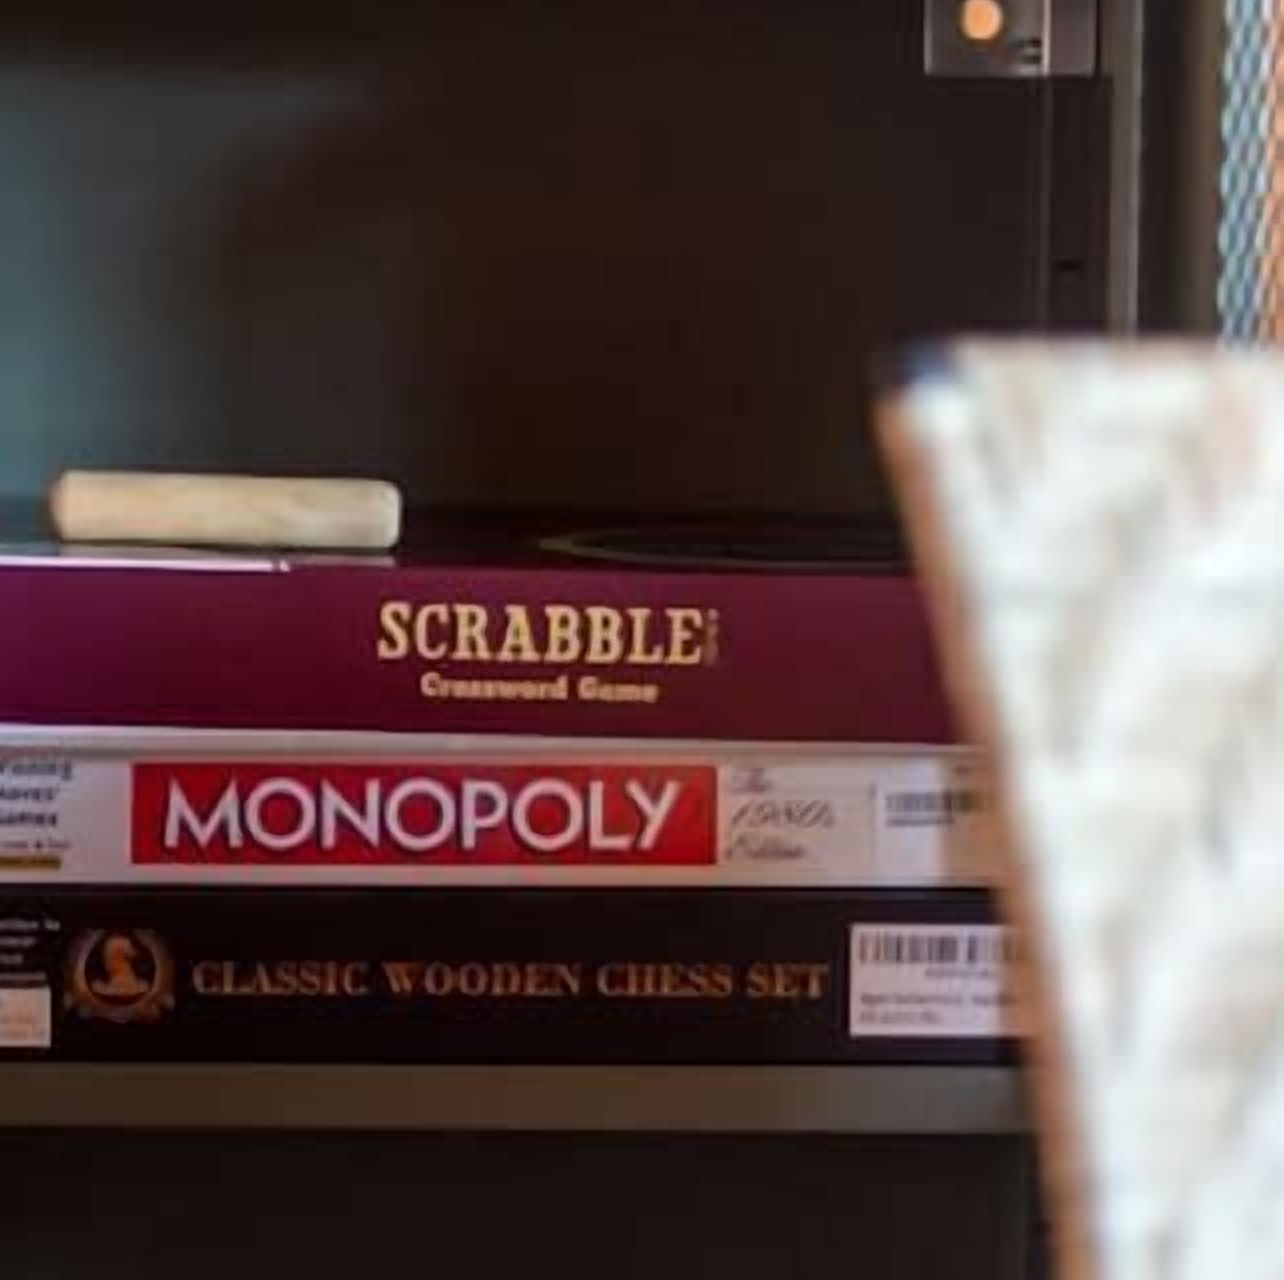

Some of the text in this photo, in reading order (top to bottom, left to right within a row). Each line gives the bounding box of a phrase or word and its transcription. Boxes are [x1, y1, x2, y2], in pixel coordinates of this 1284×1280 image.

[377, 601, 704, 666] SCRABBLE
[419, 671, 660, 704] Crossword Game
[164, 776, 682, 851] MONOPOLY
[191, 960, 830, 999] CLASSIC WOODEN CHESS SET
